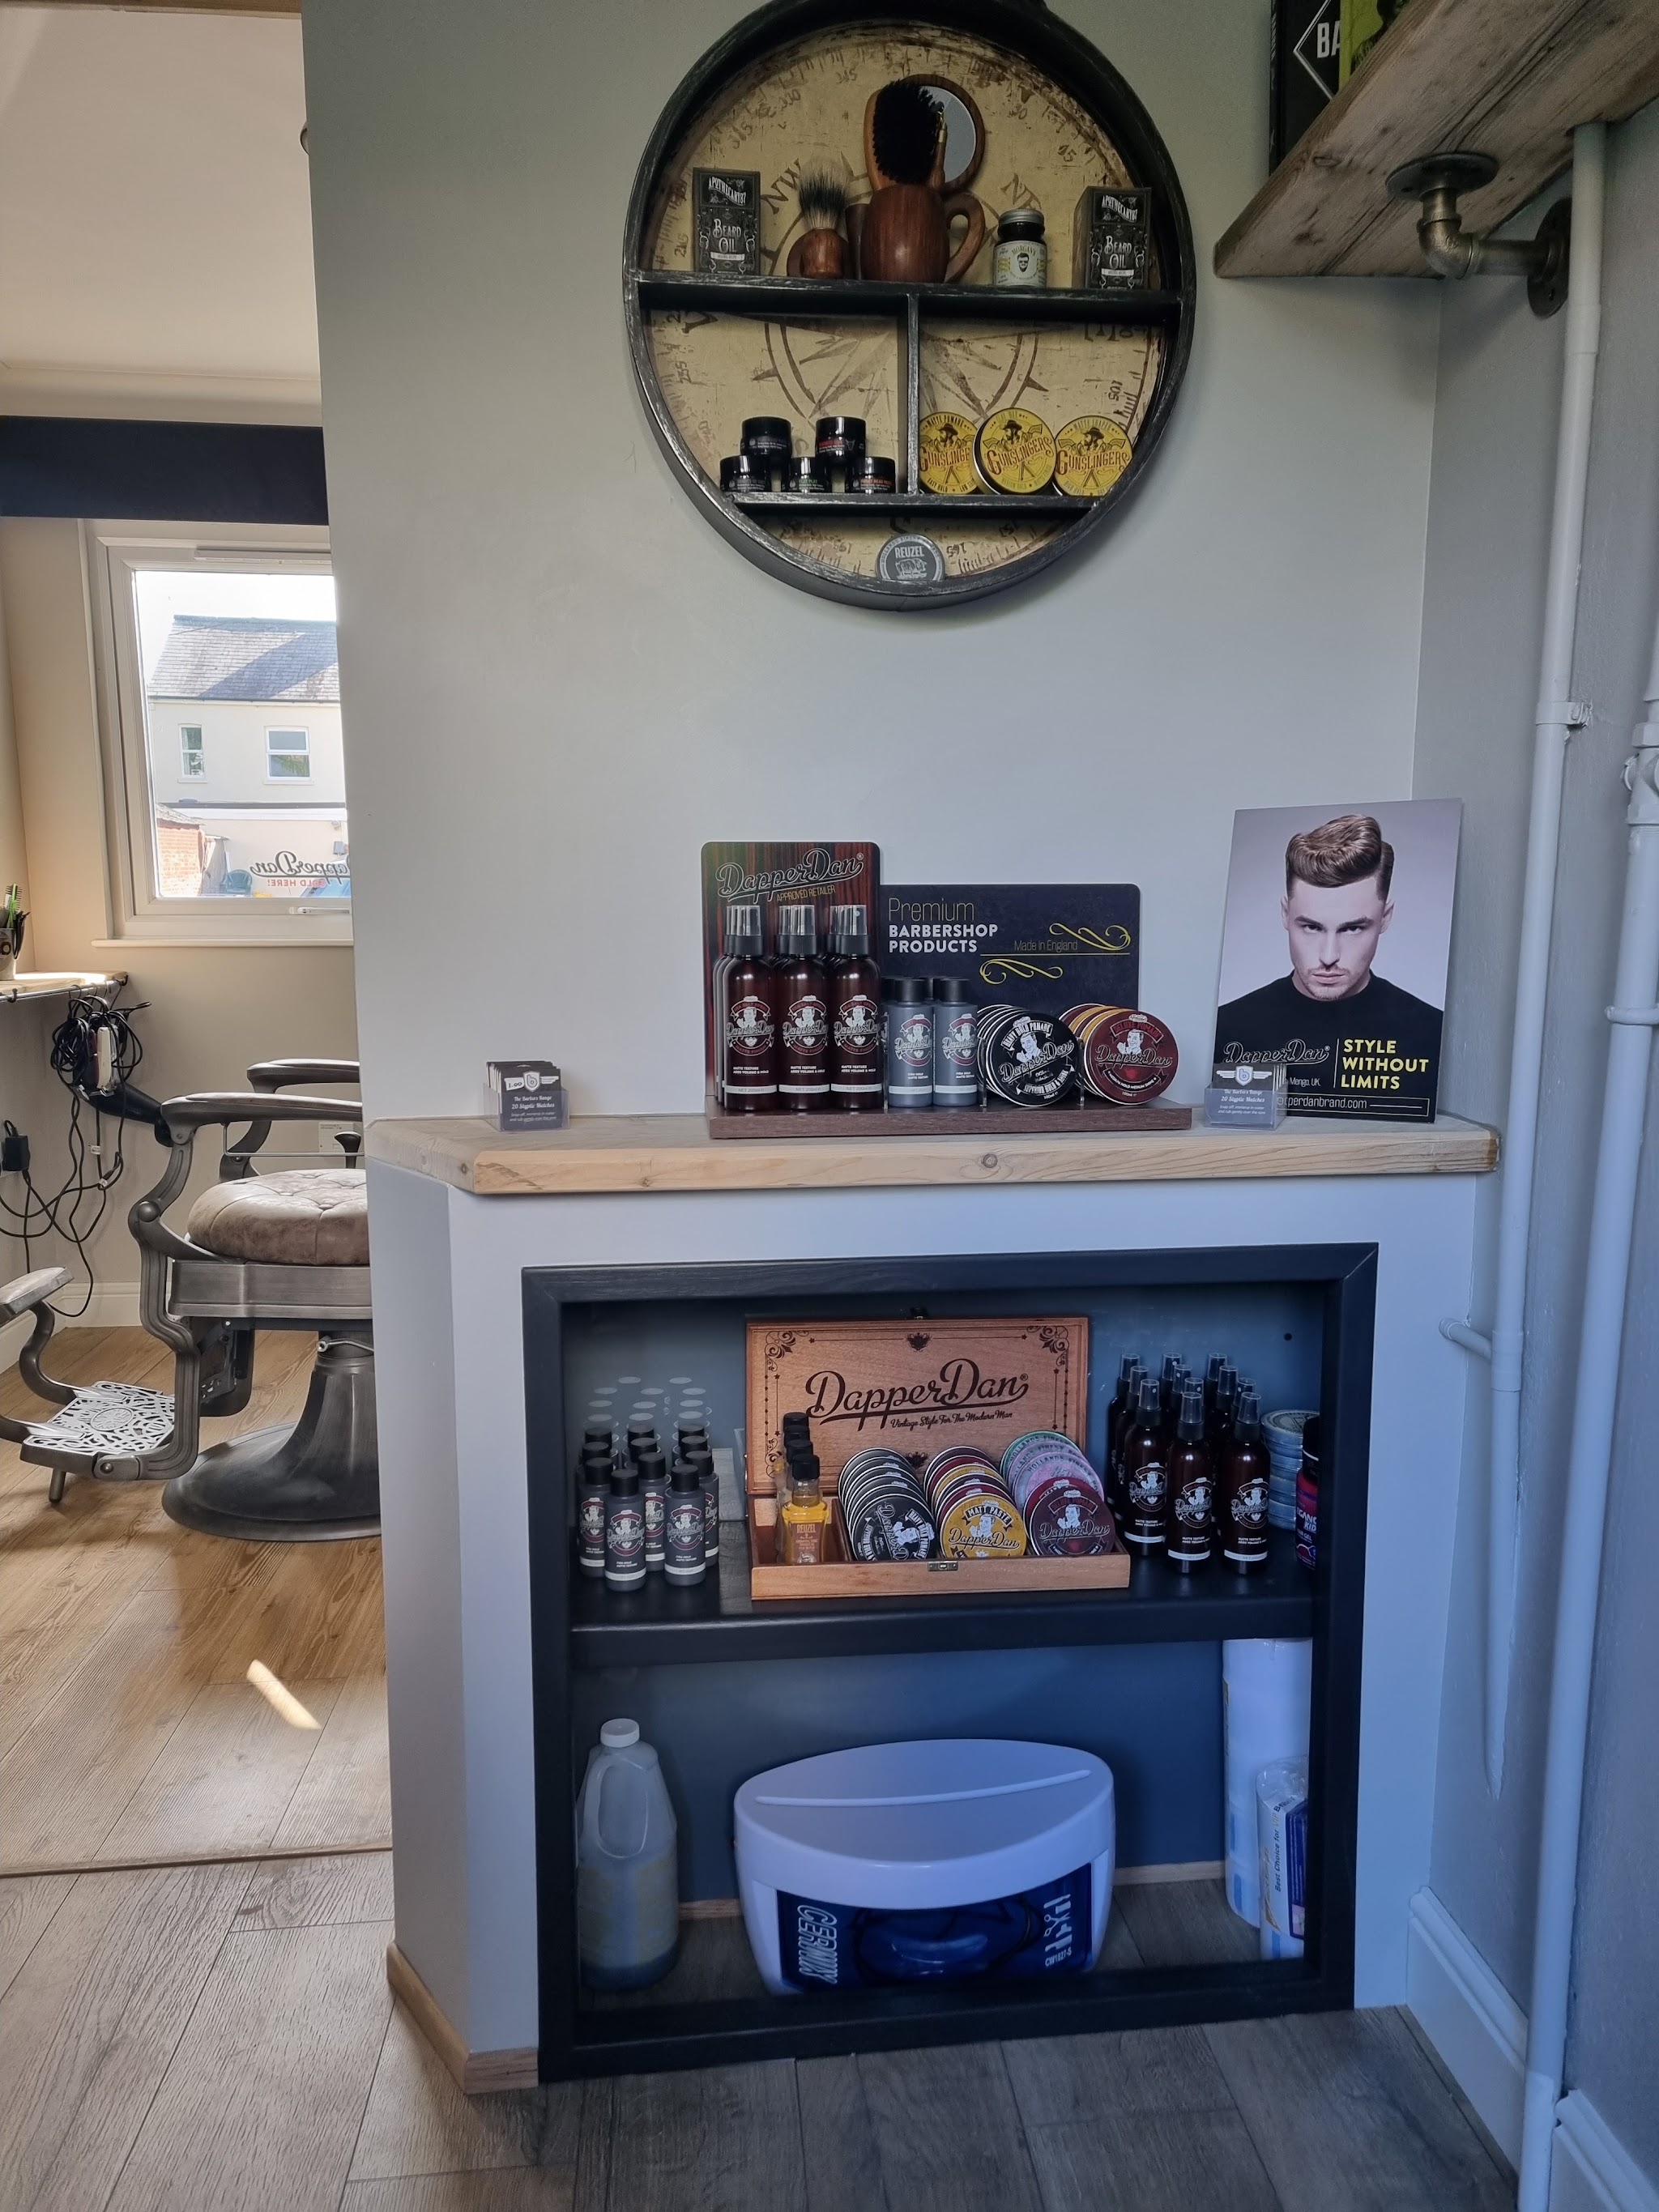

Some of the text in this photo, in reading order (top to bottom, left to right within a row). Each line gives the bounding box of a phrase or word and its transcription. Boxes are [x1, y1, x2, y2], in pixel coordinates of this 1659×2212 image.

[713, 218, 741, 238] BEARD
[719, 237, 737, 253] OIL
[1104, 235, 1132, 254] BEARD
[1109, 253, 1127, 270] OIL
[986, 436, 1054, 475] GUNSLINGERS
[1056, 450, 1130, 476] GUNSLINGERS
[894, 545, 924, 559] REUZEL
[777, 884, 835, 901] APPROVED RETAILER
[889, 897, 975, 922] Premium
[889, 924, 998, 938] BARBERSHOP
[889, 940, 978, 953] PRODUCTS
[1014, 940, 1078, 953] Made In England
[1344, 1039, 1397, 1054] STYLE
[1342, 1057, 1429, 1072] WITHOUT
[1341, 1074, 1400, 1089] LIMITS
[891, 1410, 1013, 1431] Vintage Style For The Modern Man
[968, 1507, 1010, 1523] MATT PASTE
[796, 1524, 817, 1533] REUZEL
[1274, 1877, 1282, 1893] Best
